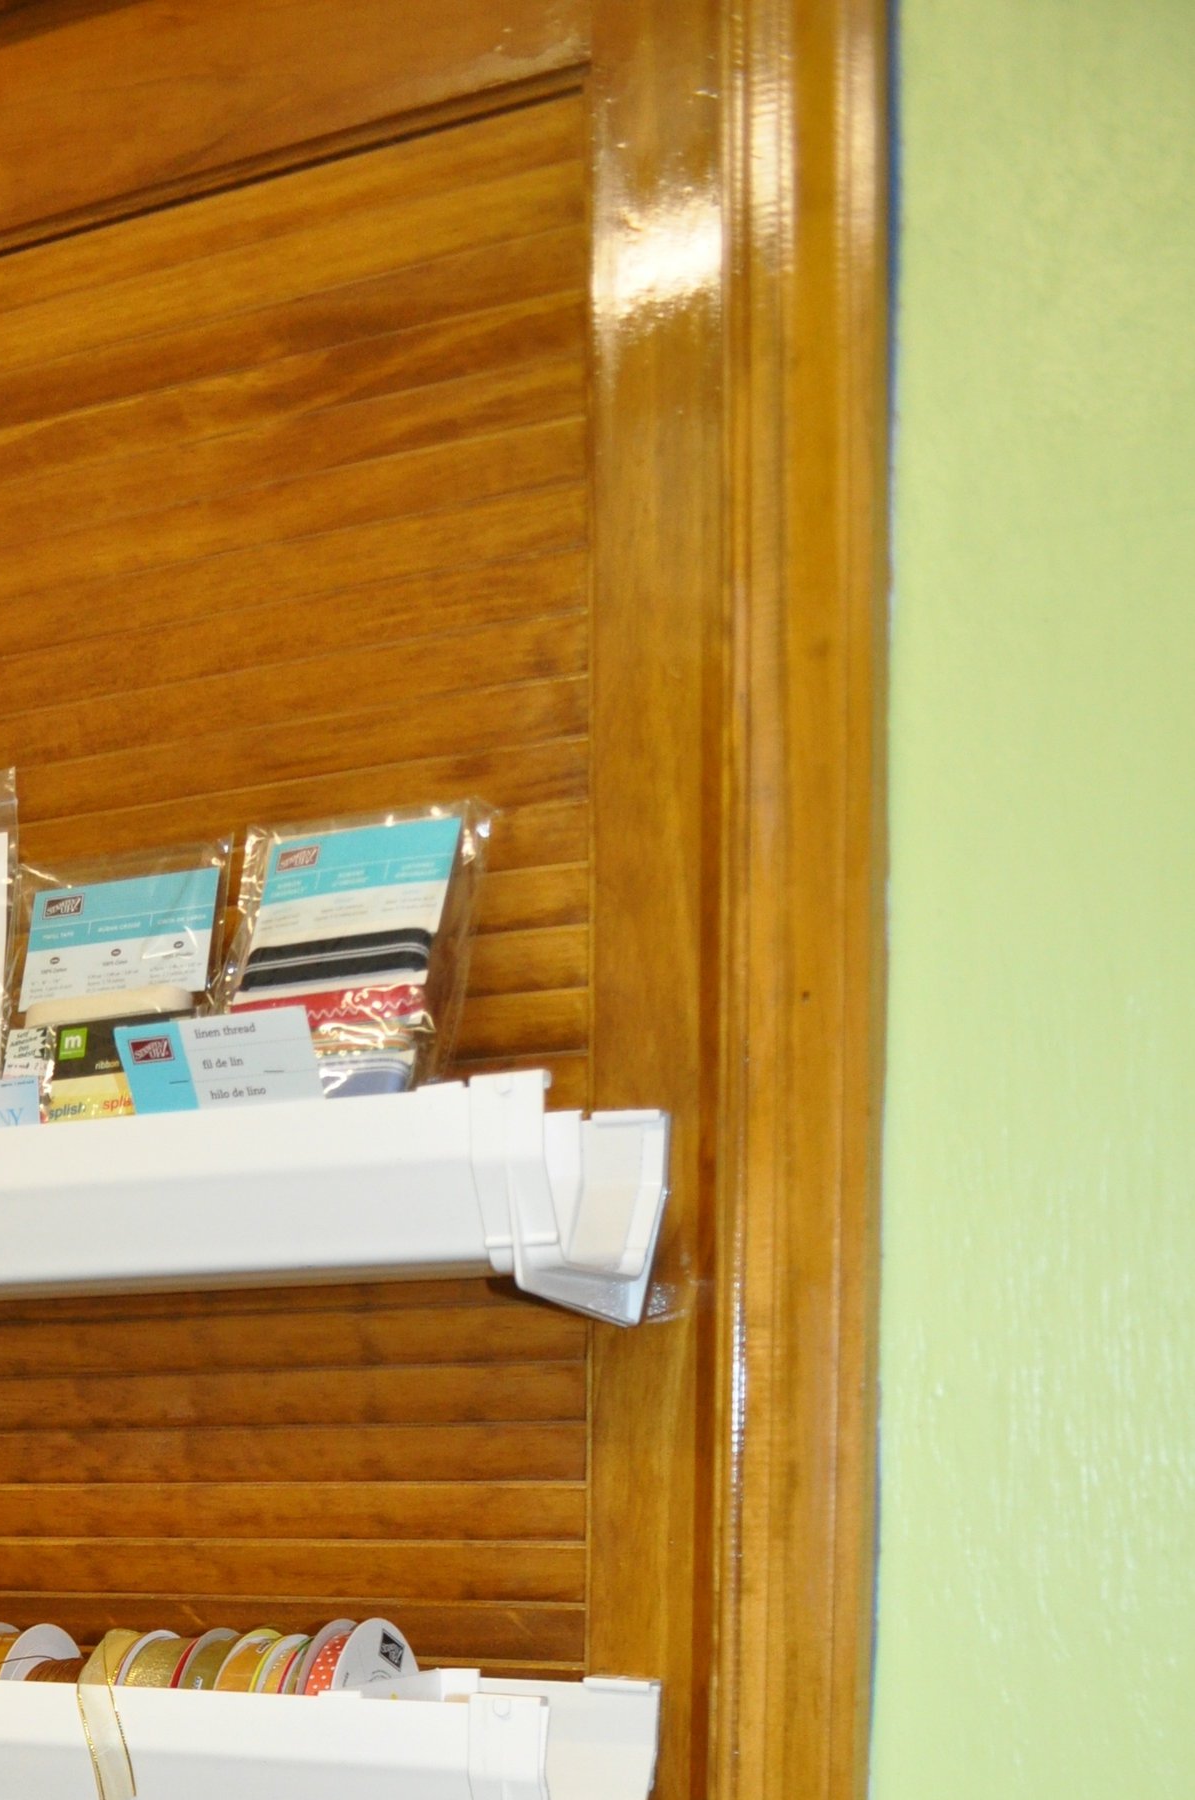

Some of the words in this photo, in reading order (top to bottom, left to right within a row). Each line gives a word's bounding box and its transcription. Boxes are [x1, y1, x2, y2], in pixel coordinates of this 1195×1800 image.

[194, 1027, 222, 1040] linen
[223, 1024, 256, 1037] thread
[95, 1060, 120, 1070] ribbon
[202, 1058, 214, 1070] fil
[215, 1058, 228, 1069] de
[230, 1056, 244, 1068] lin
[210, 1089, 230, 1100] hilo
[232, 1088, 245, 1099] de
[247, 1085, 267, 1097] lino
[49, 1102, 86, 1120] splish
